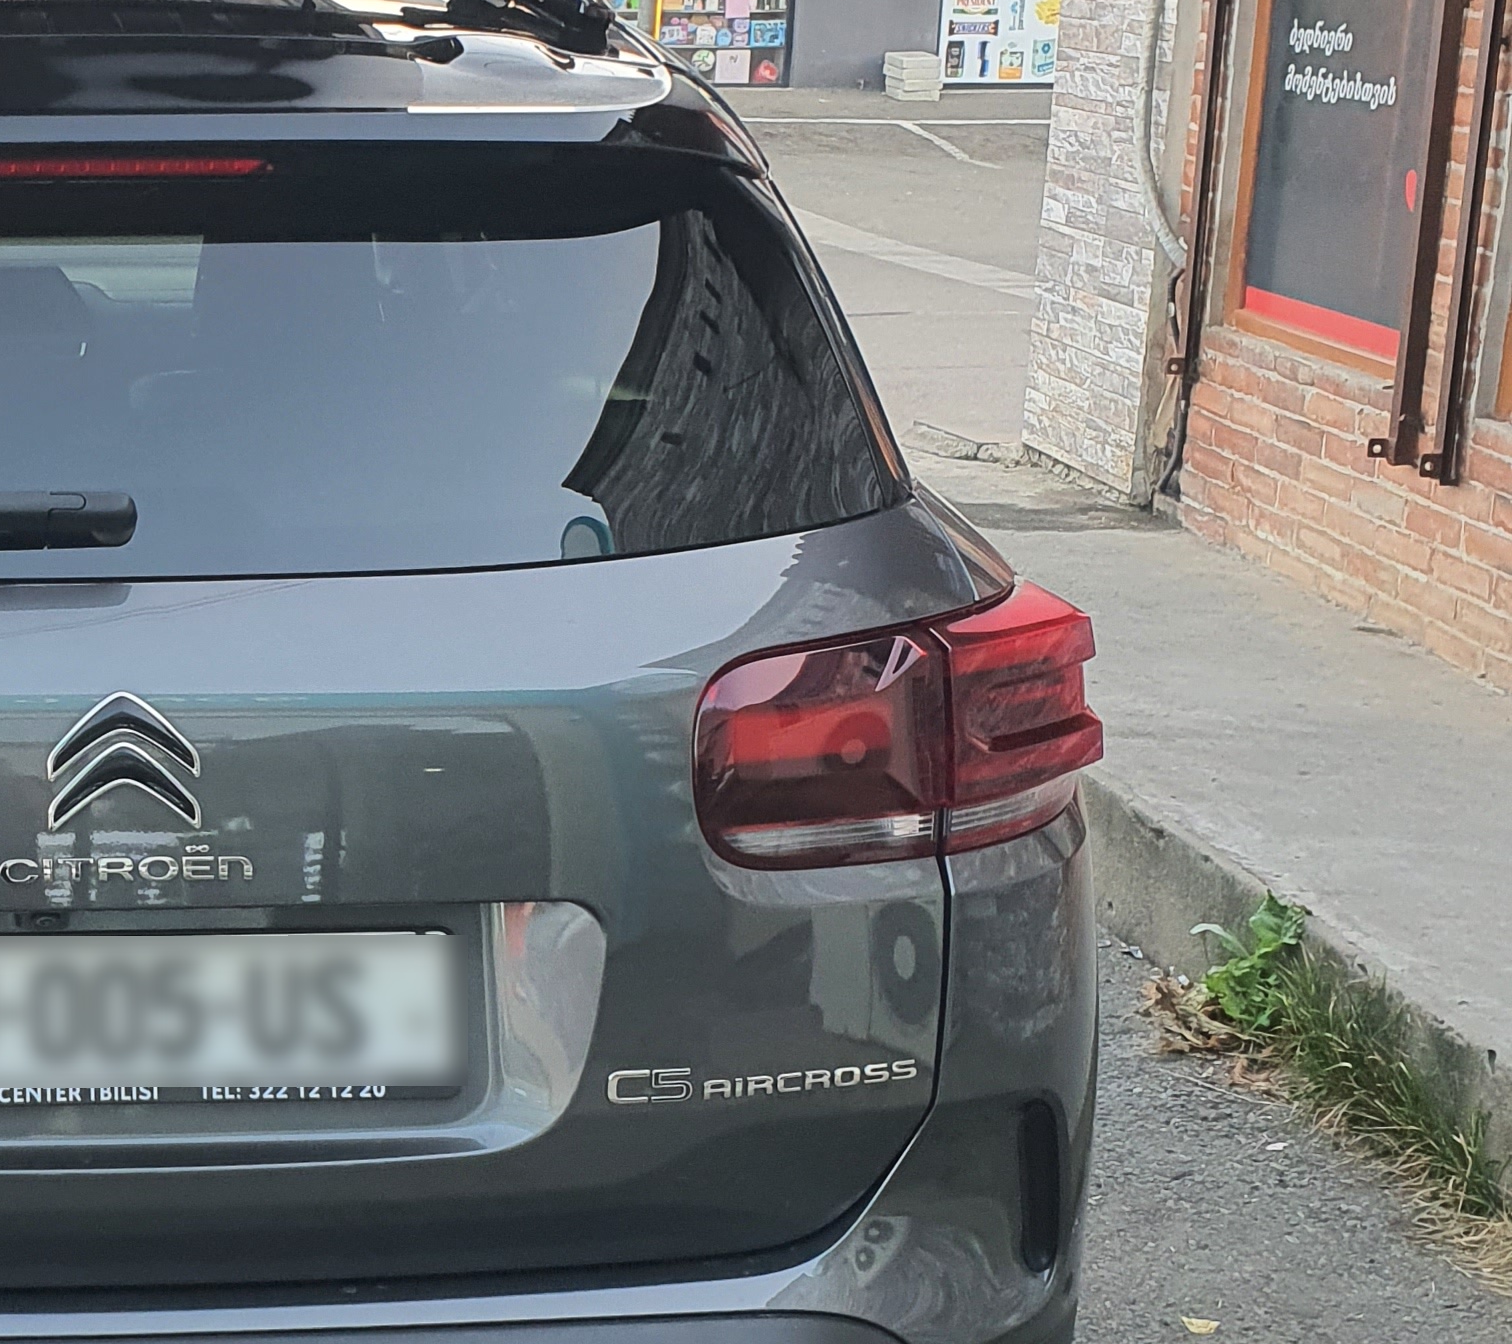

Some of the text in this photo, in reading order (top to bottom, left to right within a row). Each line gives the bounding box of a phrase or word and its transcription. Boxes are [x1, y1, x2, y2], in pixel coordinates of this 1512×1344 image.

[1290, 18, 1353, 56] ბედნიერი
[1285, 64, 1397, 110] მომენტებისთვის
[607, 1067, 693, 1104] C5
